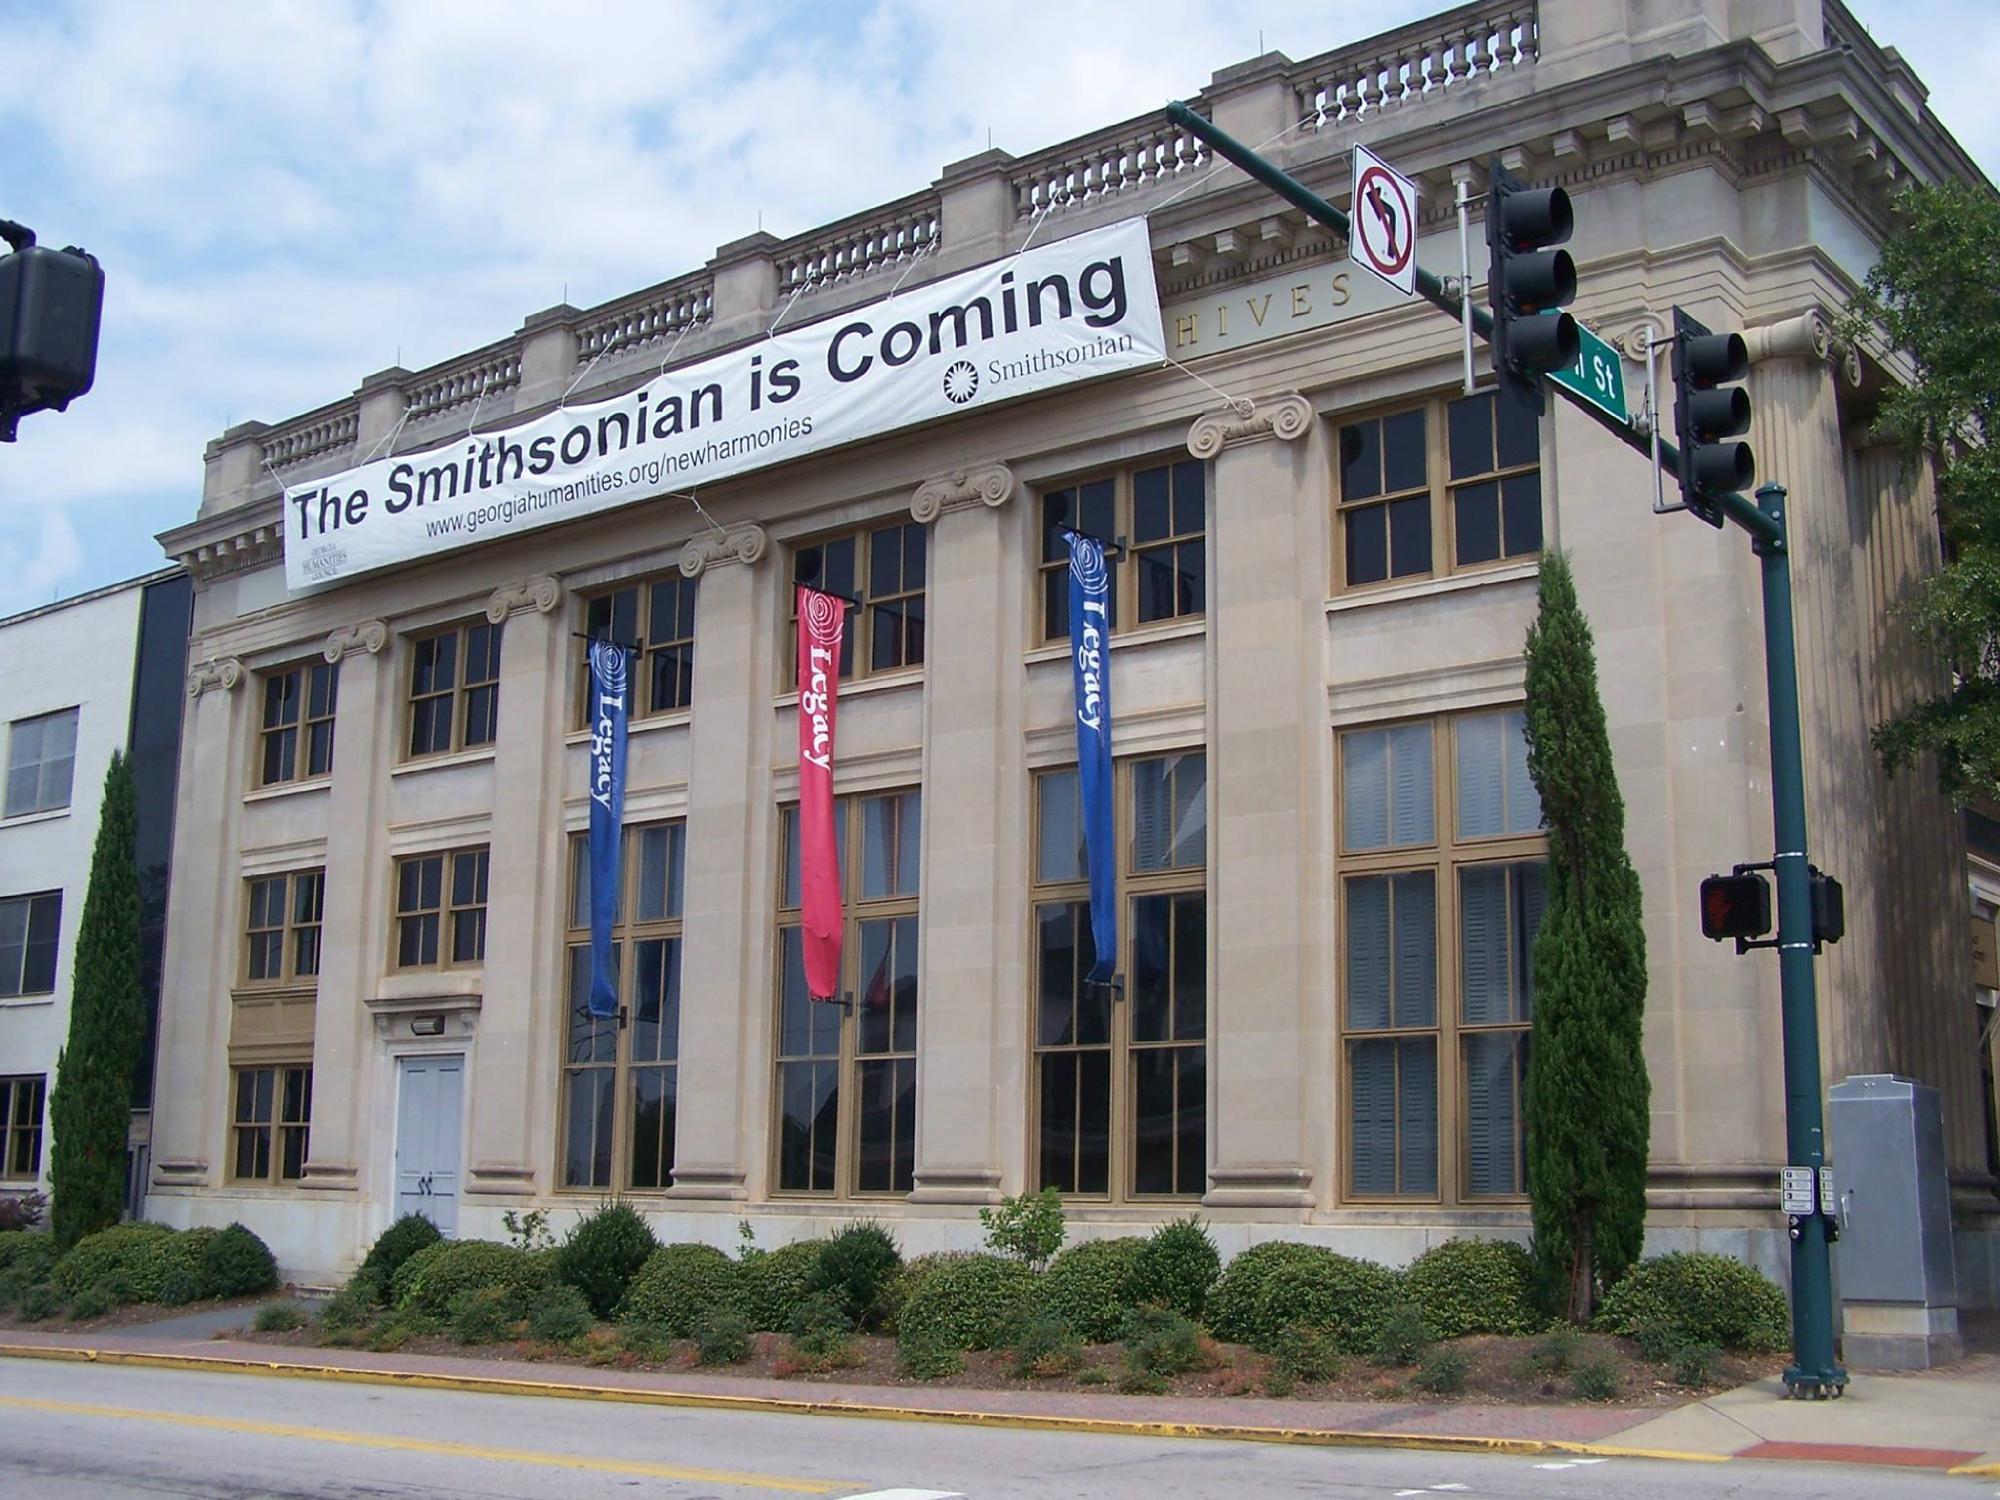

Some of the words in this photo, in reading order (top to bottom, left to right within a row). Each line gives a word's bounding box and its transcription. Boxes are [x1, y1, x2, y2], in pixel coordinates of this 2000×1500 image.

[291, 489, 369, 539] The
[385, 381, 723, 514] Smithsonian
[749, 354, 802, 411] is
[826, 255, 1127, 382] Coming
[988, 333, 1133, 384] Smithsonian
[1593, 354, 1615, 399] St
[425, 415, 813, 538] www.georgiahumanities.org/newharmonies
[801, 645, 832, 773] Legacy
[1078, 600, 1106, 731] Legacy
[590, 692, 623, 811] Legacy
